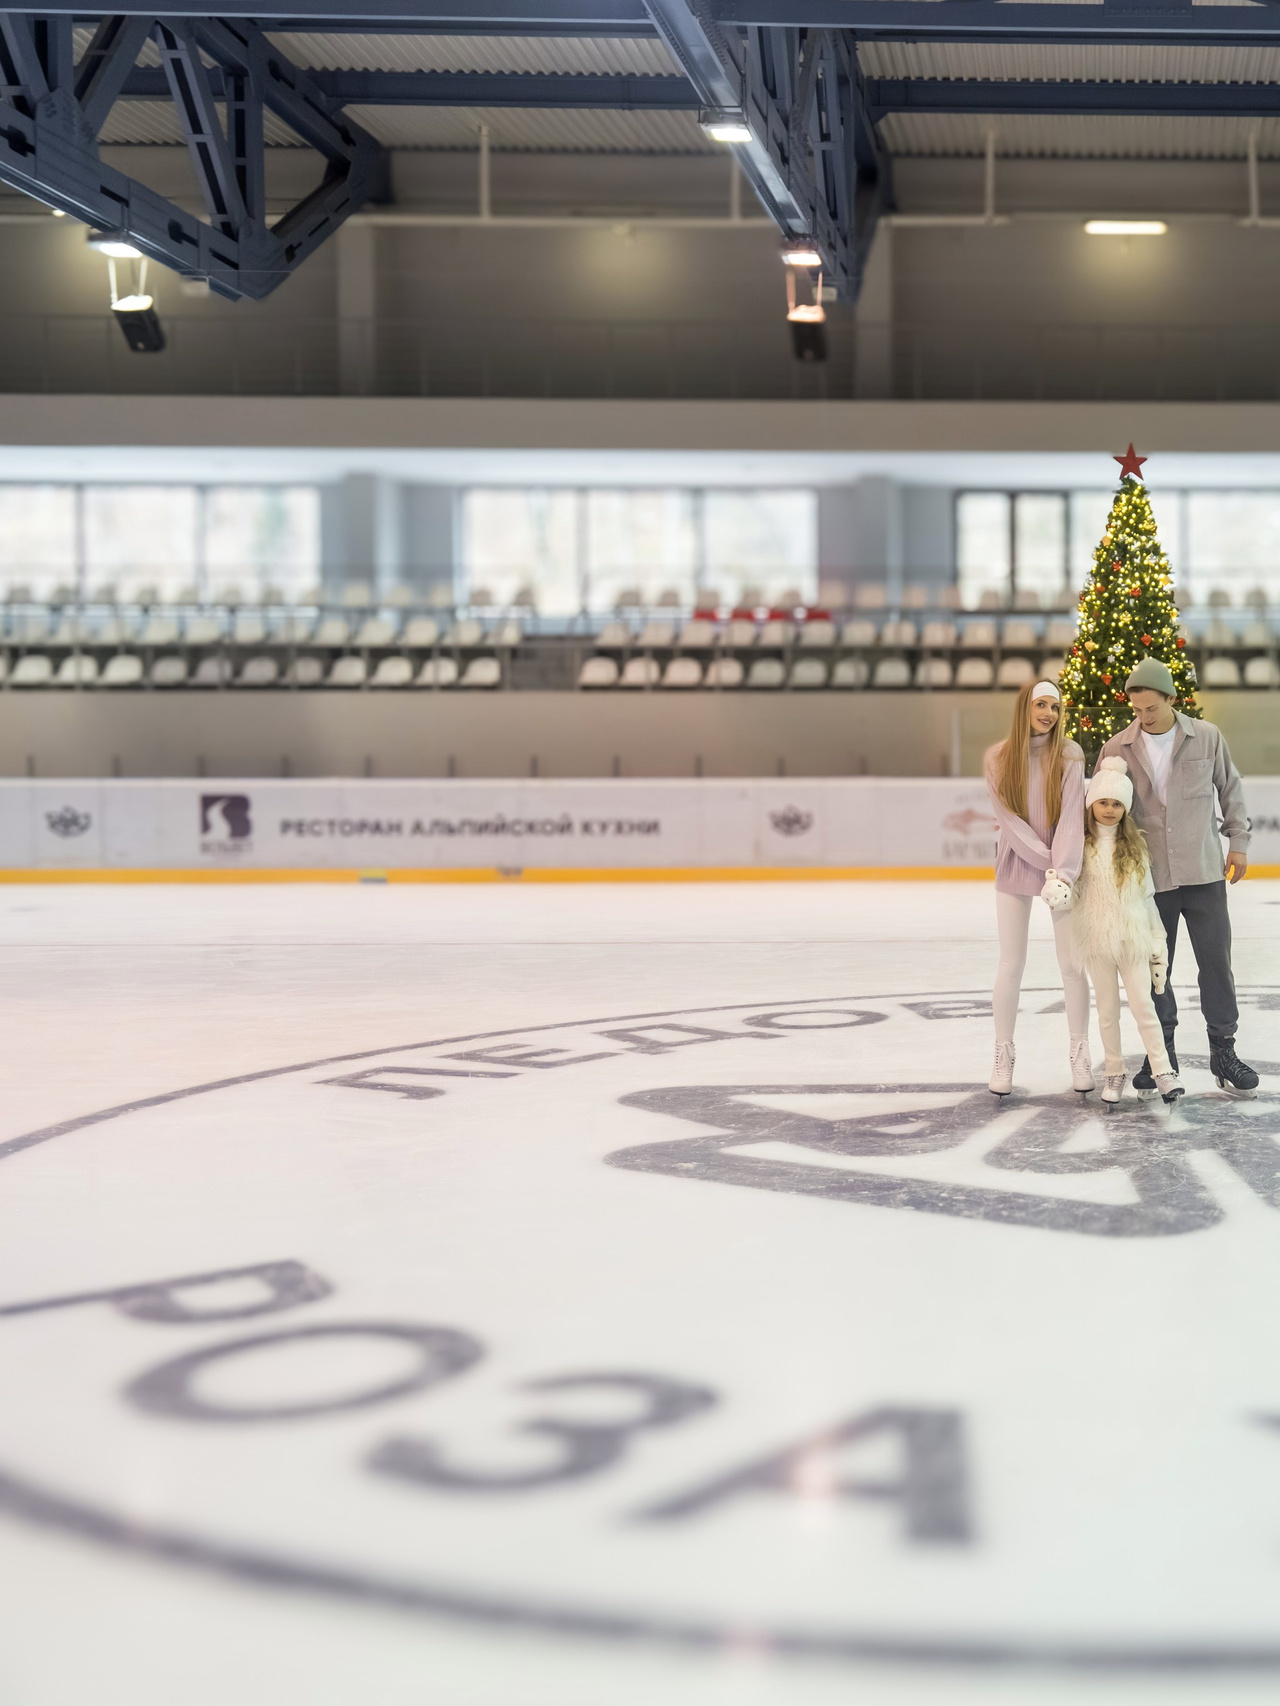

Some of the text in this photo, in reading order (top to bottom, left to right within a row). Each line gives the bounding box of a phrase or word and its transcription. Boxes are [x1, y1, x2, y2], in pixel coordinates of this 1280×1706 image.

[279, 812, 660, 837] РЕСТОРАН АЛЬПИЙСКОЙ КУХНИ
[0, 1258, 980, 1550] РОЗА
